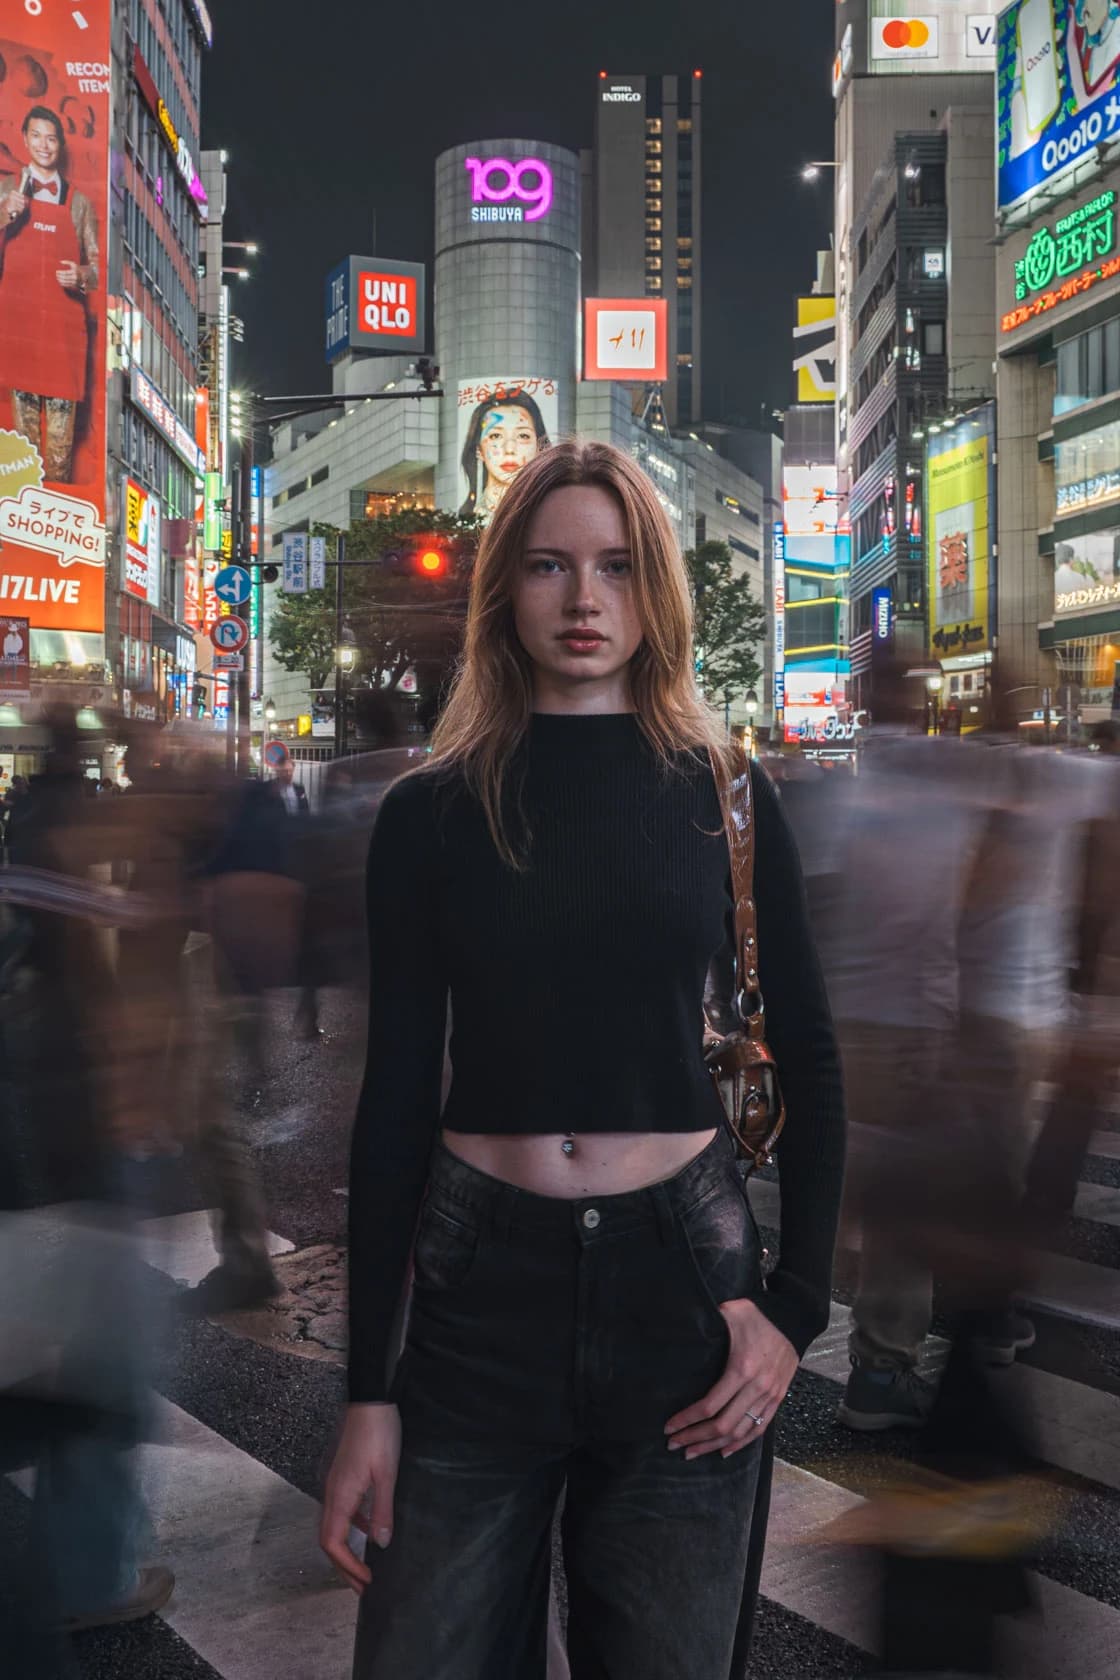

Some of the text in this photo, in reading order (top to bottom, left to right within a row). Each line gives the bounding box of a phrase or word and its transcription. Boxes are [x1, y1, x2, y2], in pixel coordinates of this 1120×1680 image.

[602, 92, 641, 102] INDIGO
[1042, 111, 1102, 171] Qoo10
[465, 157, 552, 221] 109
[471, 207, 522, 221] SHIBUYA
[1056, 209, 1113, 277] 西村
[331, 273, 344, 312] THE
[364, 279, 406, 305] UNI
[327, 304, 348, 349] PRIME
[364, 304, 410, 330] QLO
[8, 513, 100, 552] SHOPPING!
